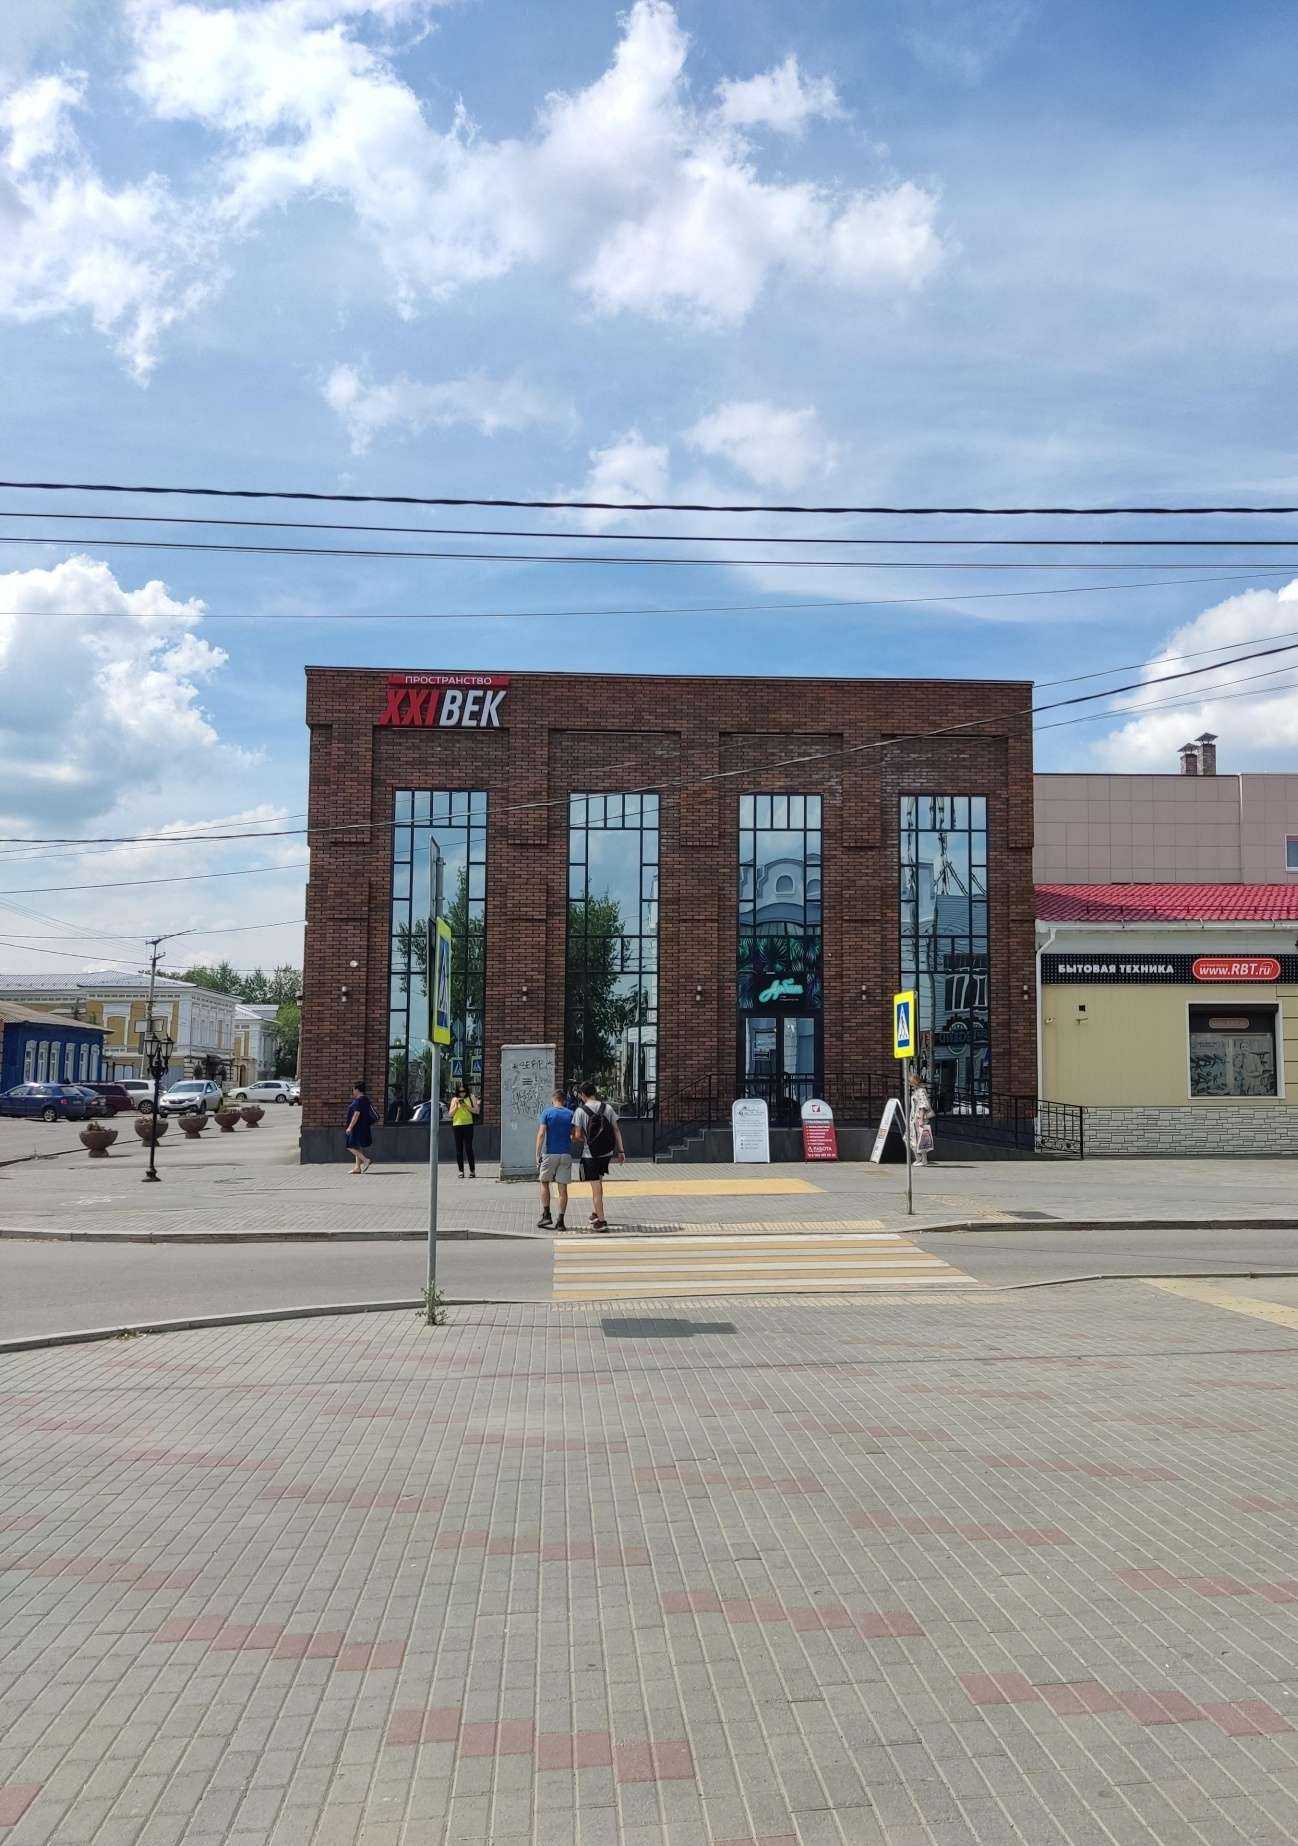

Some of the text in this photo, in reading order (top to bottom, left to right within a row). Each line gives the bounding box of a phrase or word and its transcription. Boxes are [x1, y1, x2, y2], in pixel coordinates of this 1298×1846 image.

[405, 675, 492, 685] ПРОСТРАНСТВО
[439, 689, 507, 727] ВЕК
[1058, 964, 1175, 974] БЫТОВАЯ ТЕХНИКА
[1199, 963, 1271, 975] www.RBT.ru
